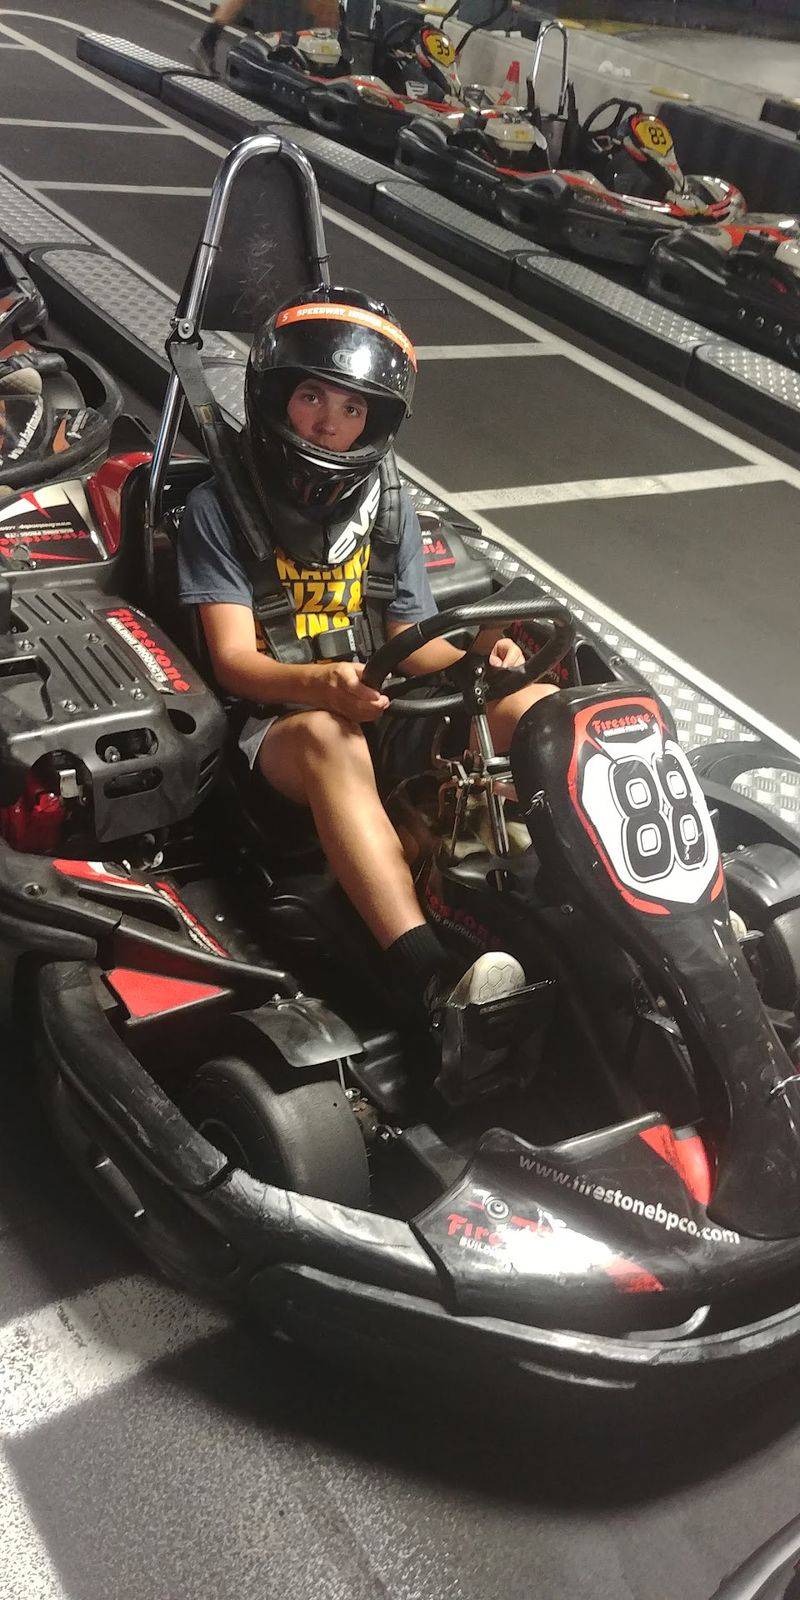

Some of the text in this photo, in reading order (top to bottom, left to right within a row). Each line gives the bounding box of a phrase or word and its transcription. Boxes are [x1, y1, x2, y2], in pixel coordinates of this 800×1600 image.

[648, 126, 667, 146] 83
[106, 608, 190, 692] Firestone
[592, 713, 652, 735] Firestone
[608, 750, 709, 884] 88
[518, 1154, 741, 1245] www.firestonebpco.com
